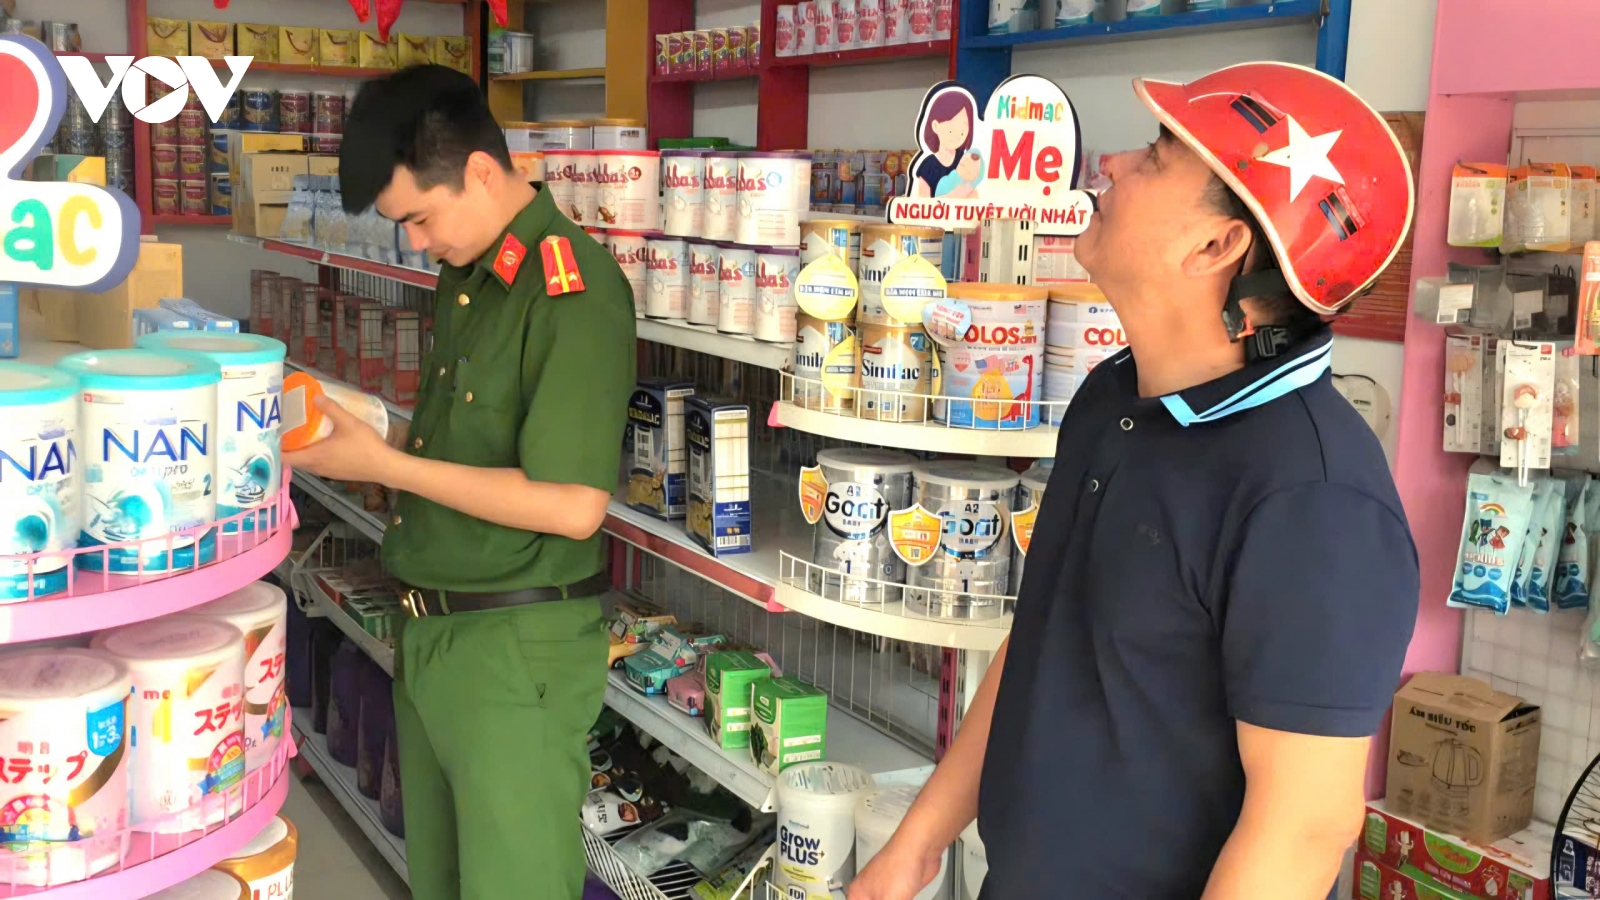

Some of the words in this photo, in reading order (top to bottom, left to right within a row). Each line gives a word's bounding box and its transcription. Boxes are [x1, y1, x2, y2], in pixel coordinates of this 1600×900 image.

[997, 95, 1063, 122] Kidmac
[988, 129, 1063, 196] Mẹ
[862, 358, 919, 380] Similac
[103, 422, 207, 463] NAN
[203, 473, 212, 497] 2
[825, 491, 884, 519] Goat
[964, 503, 979, 513] A2
[961, 579, 968, 593] 1
[780, 825, 820, 850] Grow
